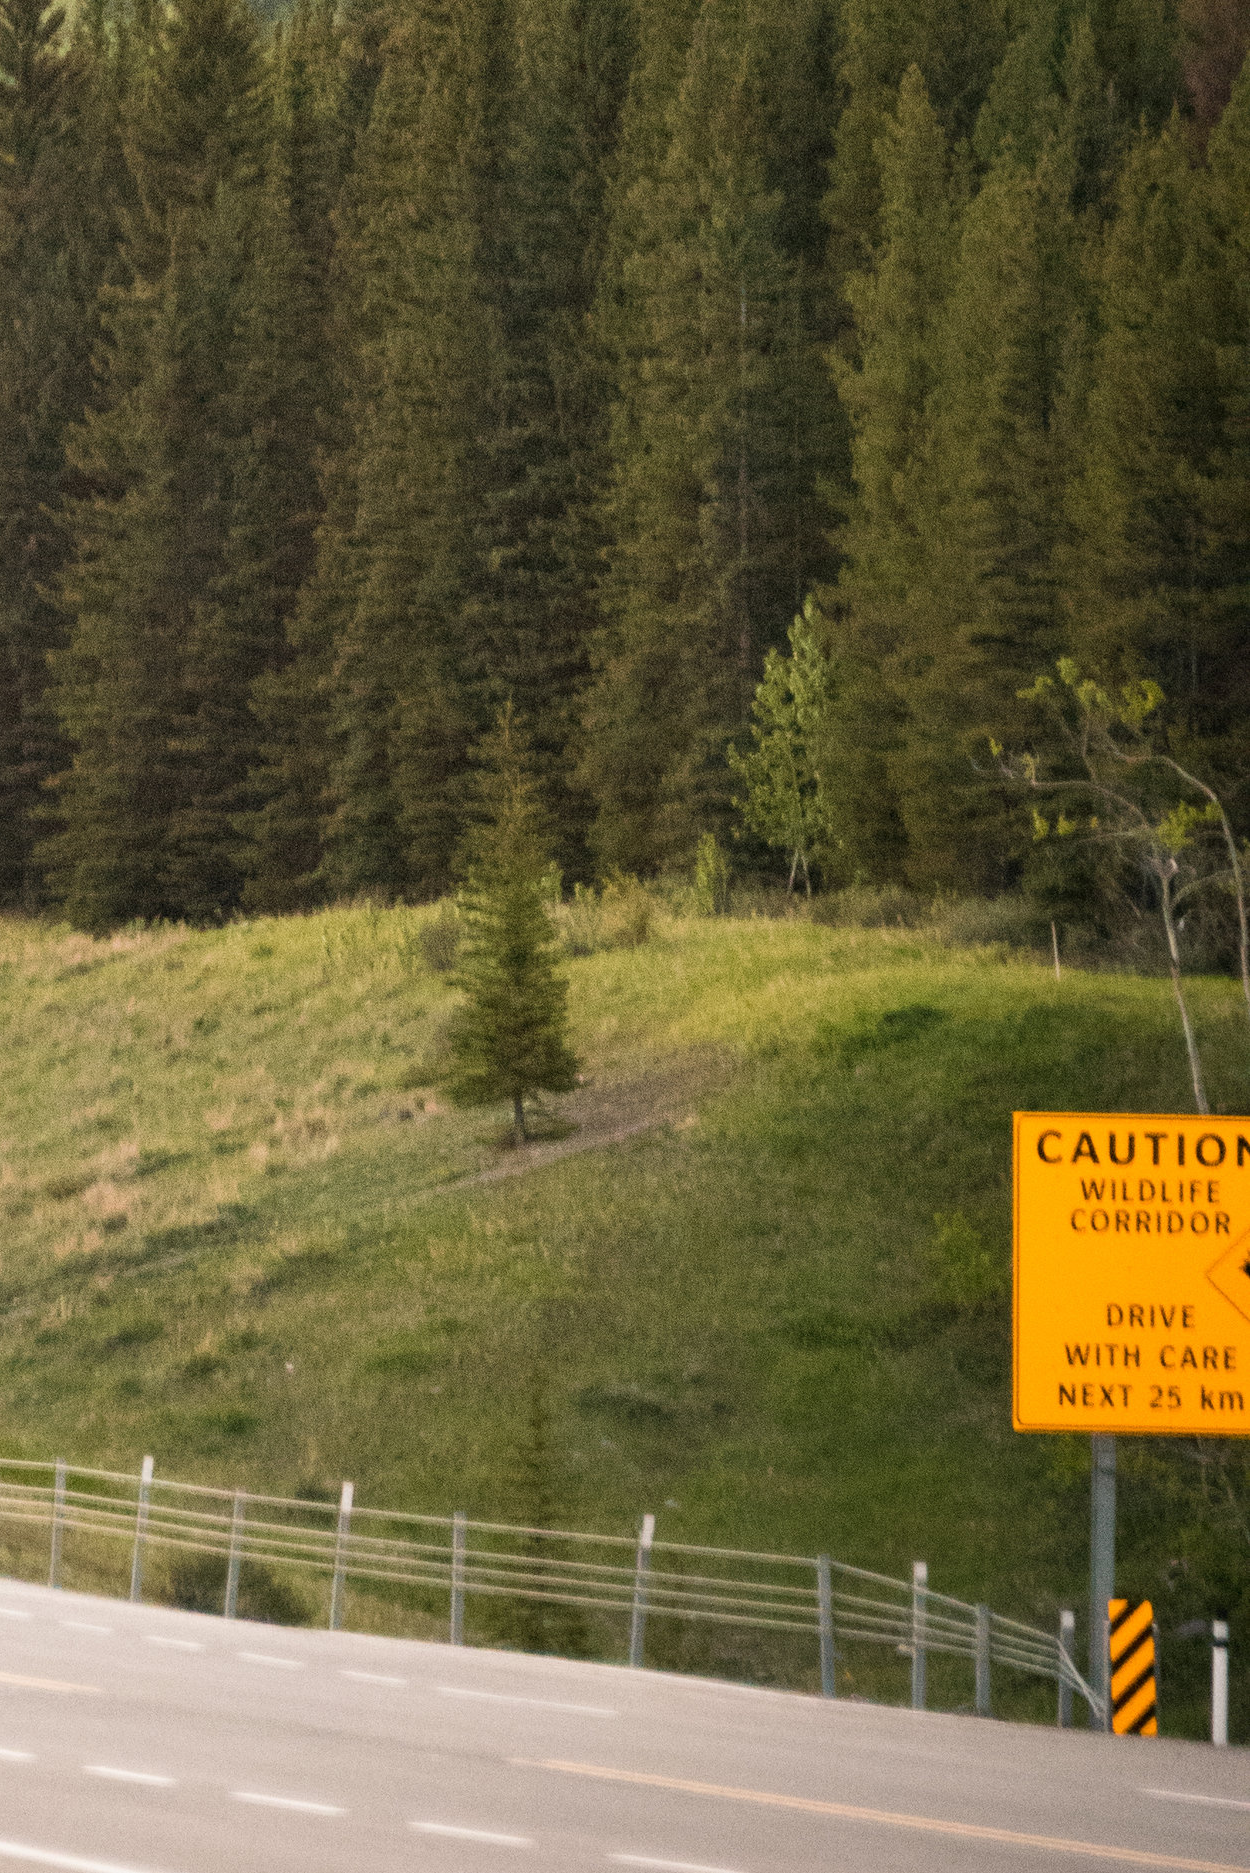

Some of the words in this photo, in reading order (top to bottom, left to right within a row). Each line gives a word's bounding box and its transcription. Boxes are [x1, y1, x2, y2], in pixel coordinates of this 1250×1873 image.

[1080, 1178, 1220, 1204] WILDLIFE
[1070, 1208, 1231, 1235] CORRIDOR
[1106, 1302, 1196, 1329] DRIVE
[1064, 1342, 1141, 1368] WITH
[1159, 1345, 1237, 1370] CARE
[1058, 1383, 1132, 1408] NEXT
[1149, 1384, 1182, 1409] 25
[1200, 1383, 1244, 1411] km
